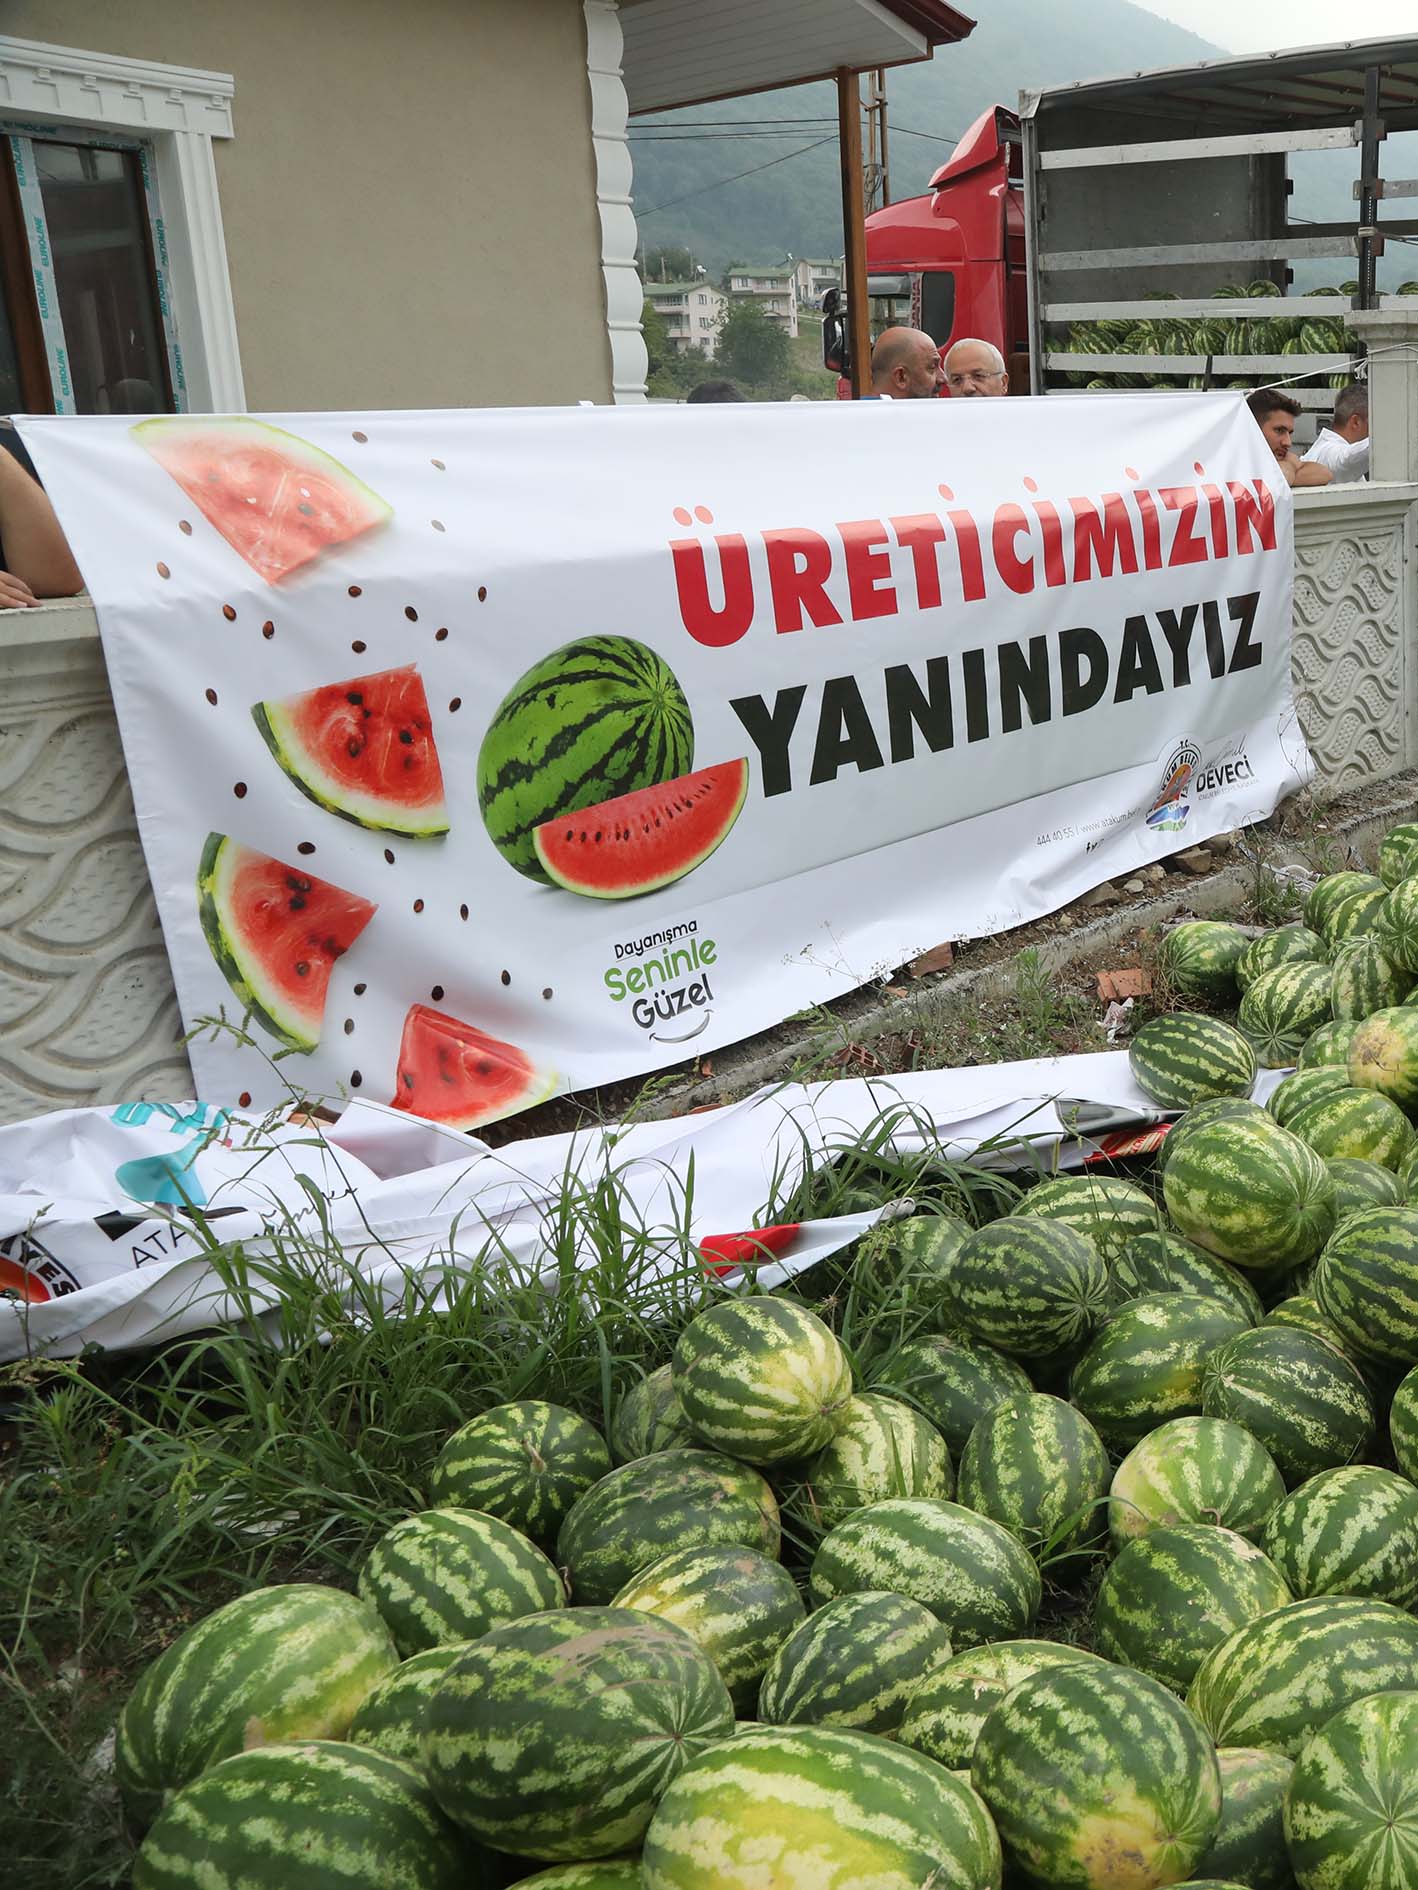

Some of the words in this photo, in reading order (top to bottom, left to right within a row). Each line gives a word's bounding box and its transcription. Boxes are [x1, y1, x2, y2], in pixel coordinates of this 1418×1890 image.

[33, 216, 50, 267] EUROLINE
[34, 269, 49, 320] EUROLINE
[56, 348, 71, 396] EUROLINE
[669, 461, 1278, 648] ÜRETİCİMİZİN
[729, 591, 1263, 799] YANINDAYIZ
[1196, 754, 1255, 793] DEVECİ
[614, 920, 698, 957] Dayanışma
[604, 938, 718, 1002] Seninle
[632, 973, 714, 1029] Güzel
